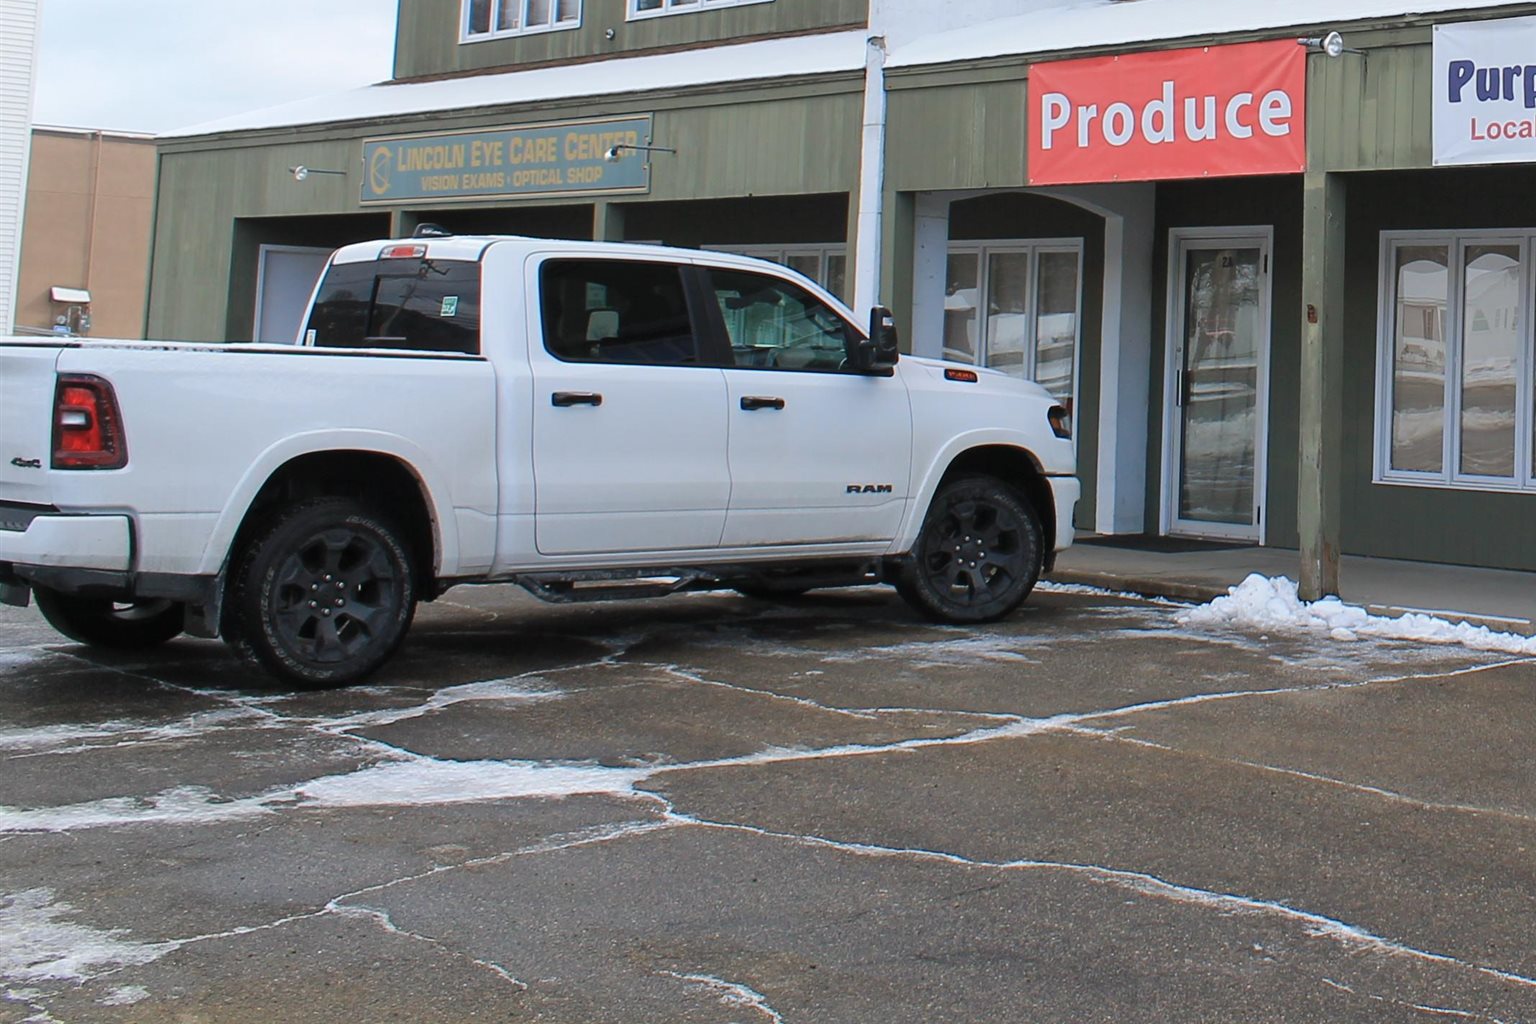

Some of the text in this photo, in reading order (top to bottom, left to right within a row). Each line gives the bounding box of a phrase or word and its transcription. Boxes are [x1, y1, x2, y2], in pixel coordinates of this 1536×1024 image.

[1041, 80, 1292, 150] Produce
[397, 130, 638, 171] LINCOLN EYE CARE CENTER
[421, 165, 603, 191] VISION EXAMS OPTICAL SHOP
[846, 484, 892, 493] RAM
